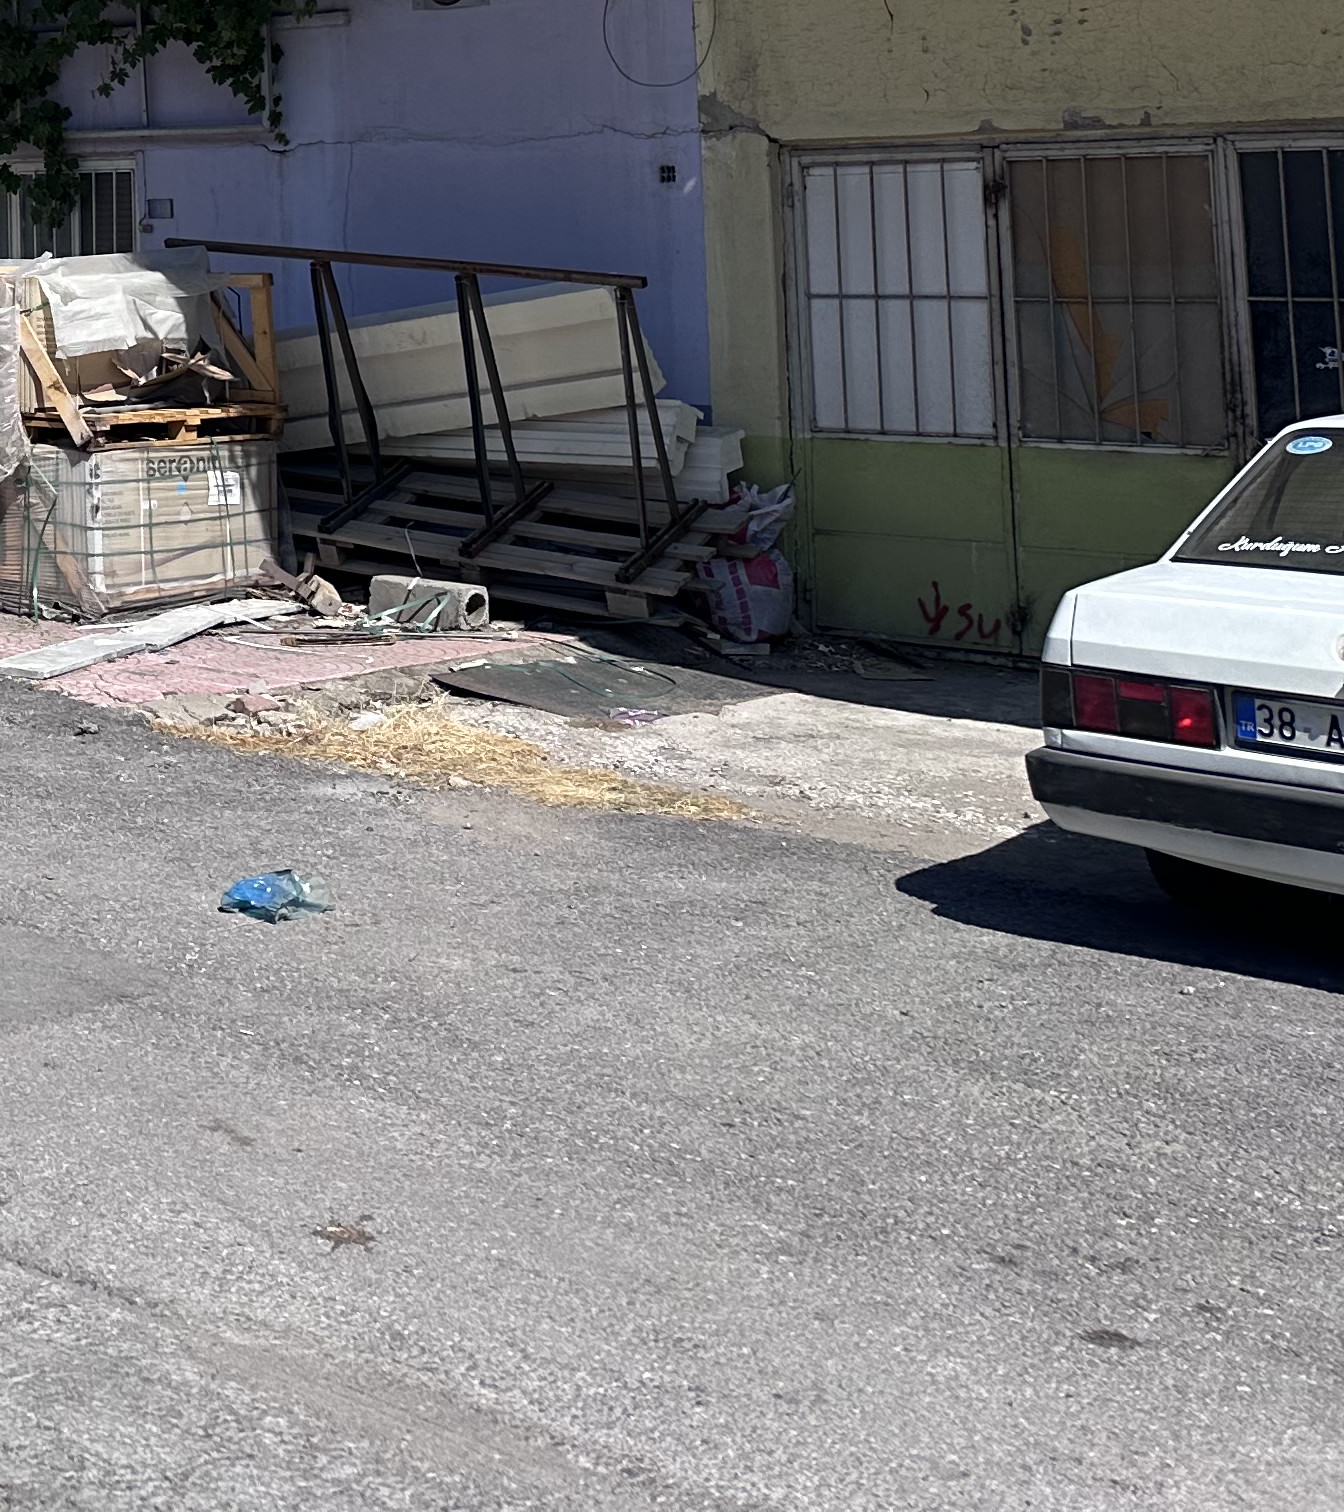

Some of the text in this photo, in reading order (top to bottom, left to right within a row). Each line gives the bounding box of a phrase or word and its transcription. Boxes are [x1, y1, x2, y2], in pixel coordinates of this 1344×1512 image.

[1239, 703, 1344, 749] TR 38 A
